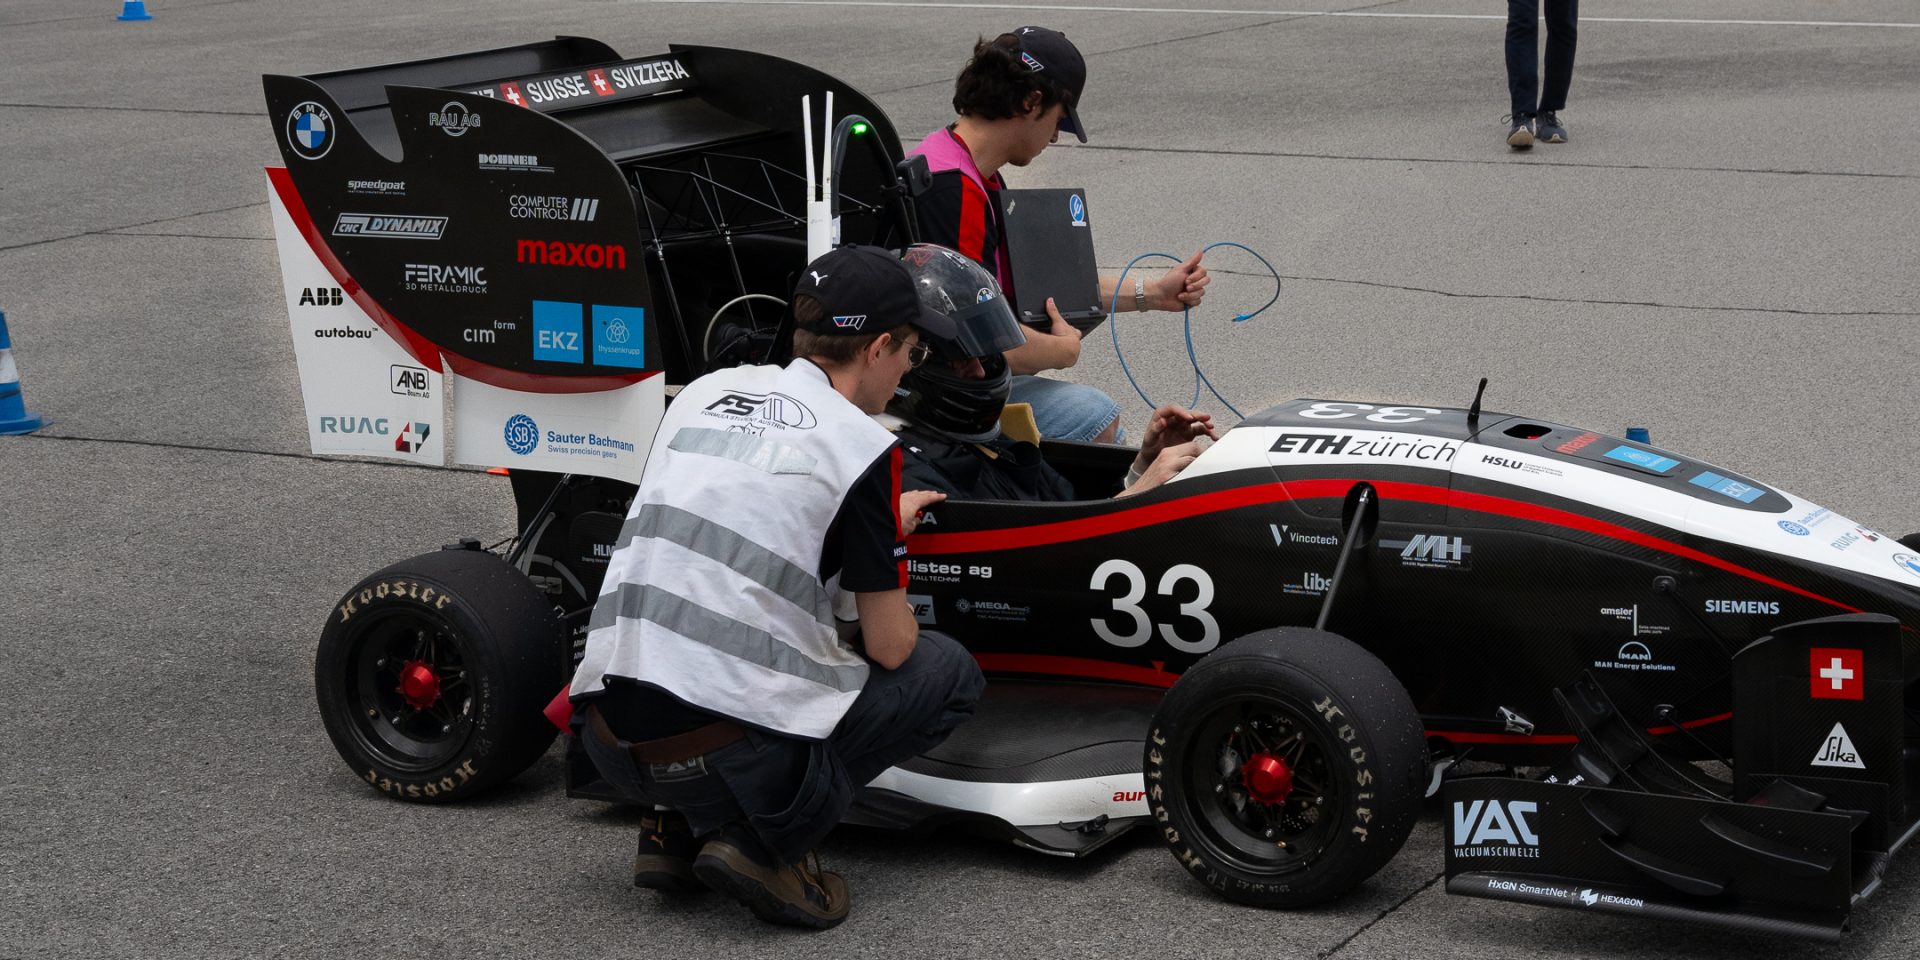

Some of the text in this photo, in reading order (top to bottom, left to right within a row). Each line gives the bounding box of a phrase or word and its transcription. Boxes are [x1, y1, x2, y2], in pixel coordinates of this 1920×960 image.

[526, 59, 690, 104] SUISSE SVIZZERA
[293, 104, 329, 121] BMW
[429, 112, 481, 128] RAU AG
[478, 153, 538, 166] DOHNER
[347, 179, 406, 191] speedgoat
[509, 195, 569, 208] COMPUTER
[509, 207, 569, 220] CONTROLS
[339, 218, 443, 233] CNC DYNAMIX
[517, 239, 626, 270] maxon
[405, 264, 488, 285] FERAMIC
[299, 287, 344, 306] ABB
[405, 282, 488, 294] 3D METALLDRUCK
[539, 330, 578, 351] EKZ
[598, 344, 641, 356] thyssenkrupp
[396, 370, 427, 390] ANB
[320, 416, 389, 435] RUAG
[701, 410, 786, 431] FORMULA STUDENT AUSTRIA
[514, 426, 529, 443] SB
[547, 431, 634, 452] Sauter Bachmann
[548, 445, 617, 459] Swiss precision gears
[1481, 454, 1523, 470] HSLU
[1290, 531, 1338, 545] Vincotech
[1400, 534, 1463, 560] MH
[968, 565, 992, 579] ag
[338, 581, 451, 623] Hoosier
[975, 601, 1011, 610] MEGA
[1090, 559, 1221, 654] 33
[1705, 600, 1780, 615] SIEMENS
[1614, 662, 1640, 671] Energy
[1641, 663, 1676, 671] Solutions
[1818, 736, 1857, 763] Sika
[1313, 696, 1374, 842] Hoosier
[1453, 799, 1539, 846] VAC
[1454, 846, 1540, 858] VACUUMSCHMELZE
[1488, 879, 1643, 907] HxGN SmartNet HEXAGON
